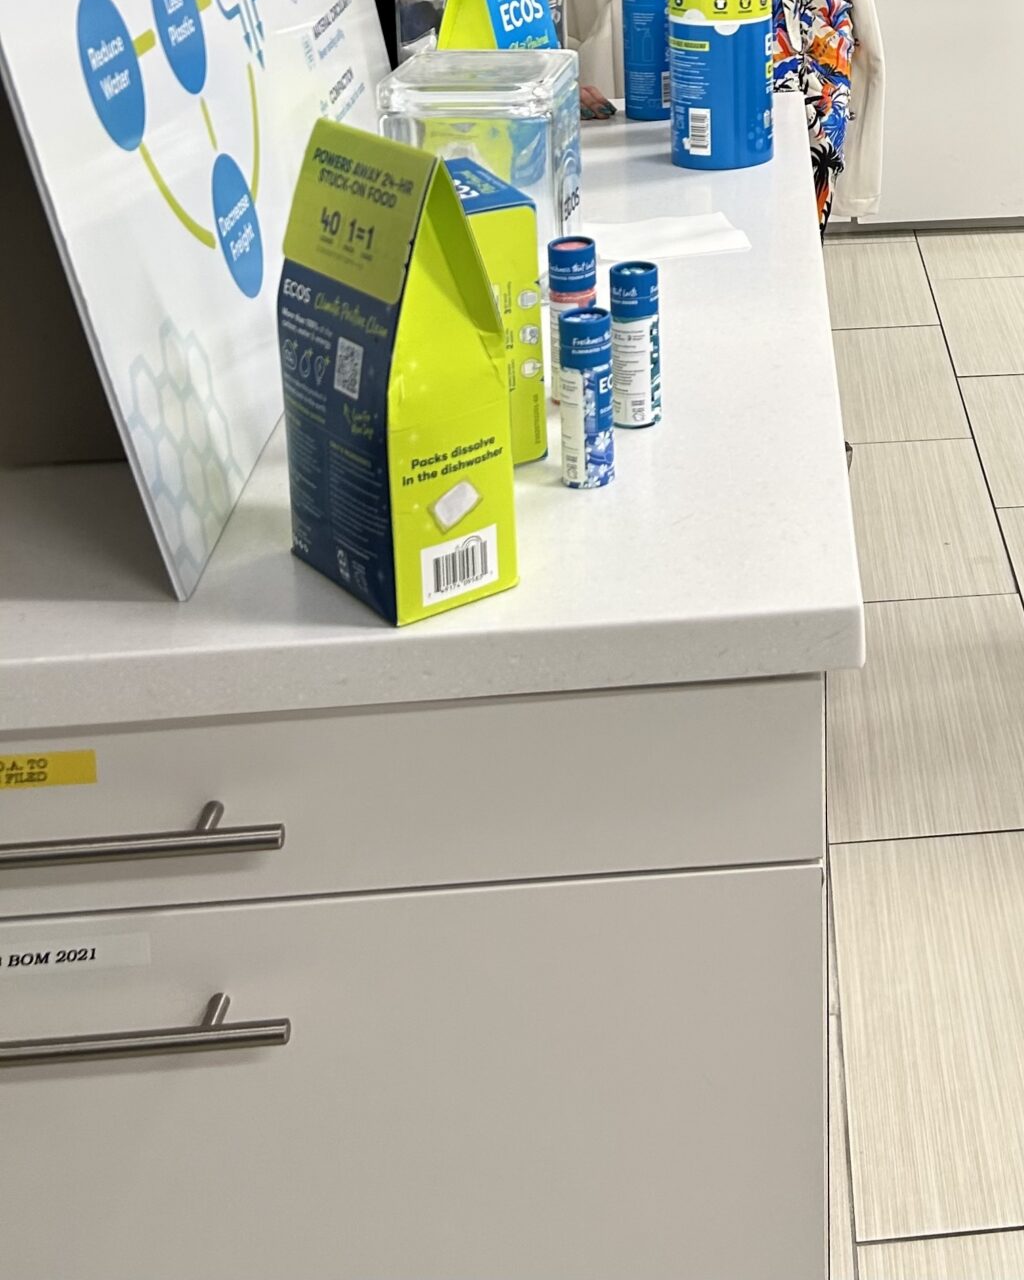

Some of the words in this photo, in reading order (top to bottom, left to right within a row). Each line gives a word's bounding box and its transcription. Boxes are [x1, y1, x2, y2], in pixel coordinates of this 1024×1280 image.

[168, 17, 196, 47] Plastic
[87, 34, 124, 72] Reduce
[100, 67, 131, 101] Water
[313, 147, 352, 172] POWERS
[353, 162, 382, 180] AWAY
[382, 173, 414, 196] 24-HR
[318, 168, 367, 197] STUCK-ON
[367, 187, 398, 208] FOOD
[218, 192, 250, 238] Decrease
[321, 206, 341, 236] 40
[229, 222, 255, 262] Freight
[283, 278, 311, 303] ECOS
[599, 373, 613, 394] EC
[402, 476, 414, 487] in
[417, 470, 438, 482] the
[441, 446, 504, 476] dishwasher
[411, 452, 448, 469] Packs
[451, 436, 495, 459] dissolve
[5, 771, 48, 784] FILED
[27, 758, 48, 769] TO
[8, 952, 51, 968] BOM
[55, 947, 97, 964] 2021
